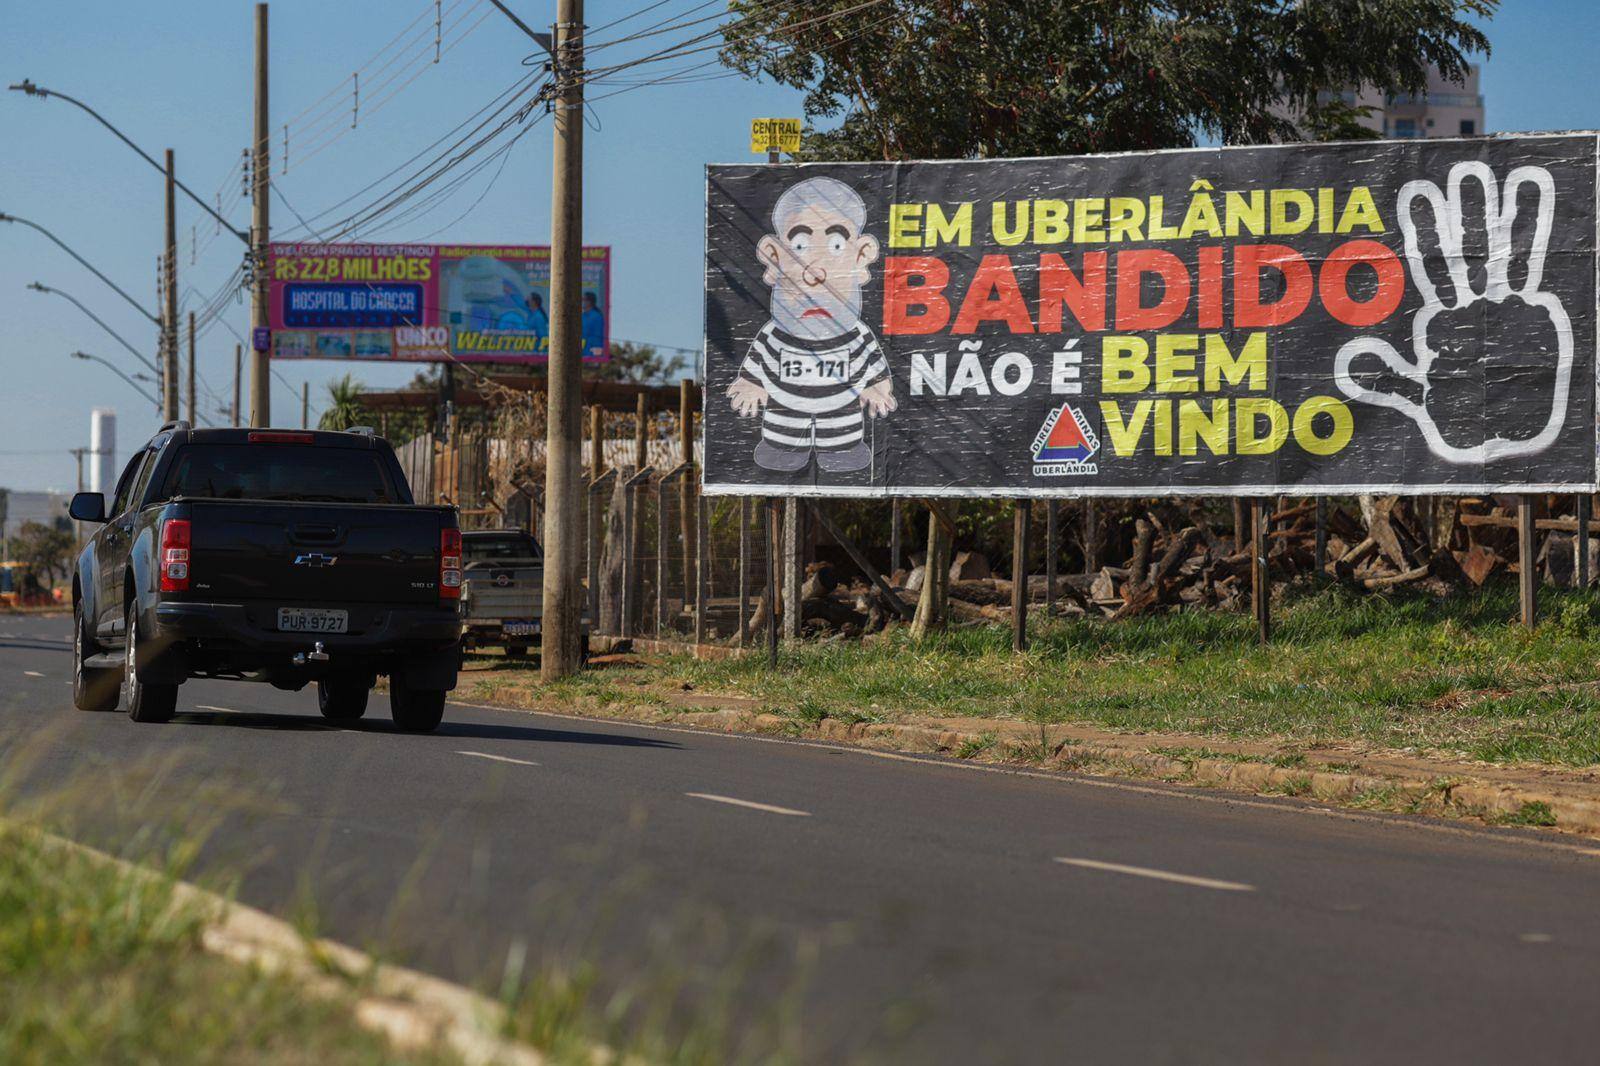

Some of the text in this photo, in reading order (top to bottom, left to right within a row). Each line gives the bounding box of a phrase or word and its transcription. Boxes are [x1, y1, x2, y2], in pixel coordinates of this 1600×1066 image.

[753, 122, 798, 134] CENTRAL
[888, 179, 1385, 249] EM UBERLÂNDIA
[330, 246, 371, 256] PRADO
[373, 246, 435, 256] DESTINOU
[275, 258, 299, 280] R$
[343, 255, 432, 280] MILHÕES
[291, 291, 349, 310] HOSPITAL
[350, 291, 367, 309] DO
[882, 239, 1405, 335] BANDIDO
[456, 331, 538, 351] WELITON
[909, 332, 1268, 396] NÃO É BEM
[1032, 410, 1060, 452] DIREITA
[1073, 410, 1099, 449] MINAS
[1099, 396, 1354, 457] VINDO
[1034, 464, 1097, 475] UBERLÂNDIA
